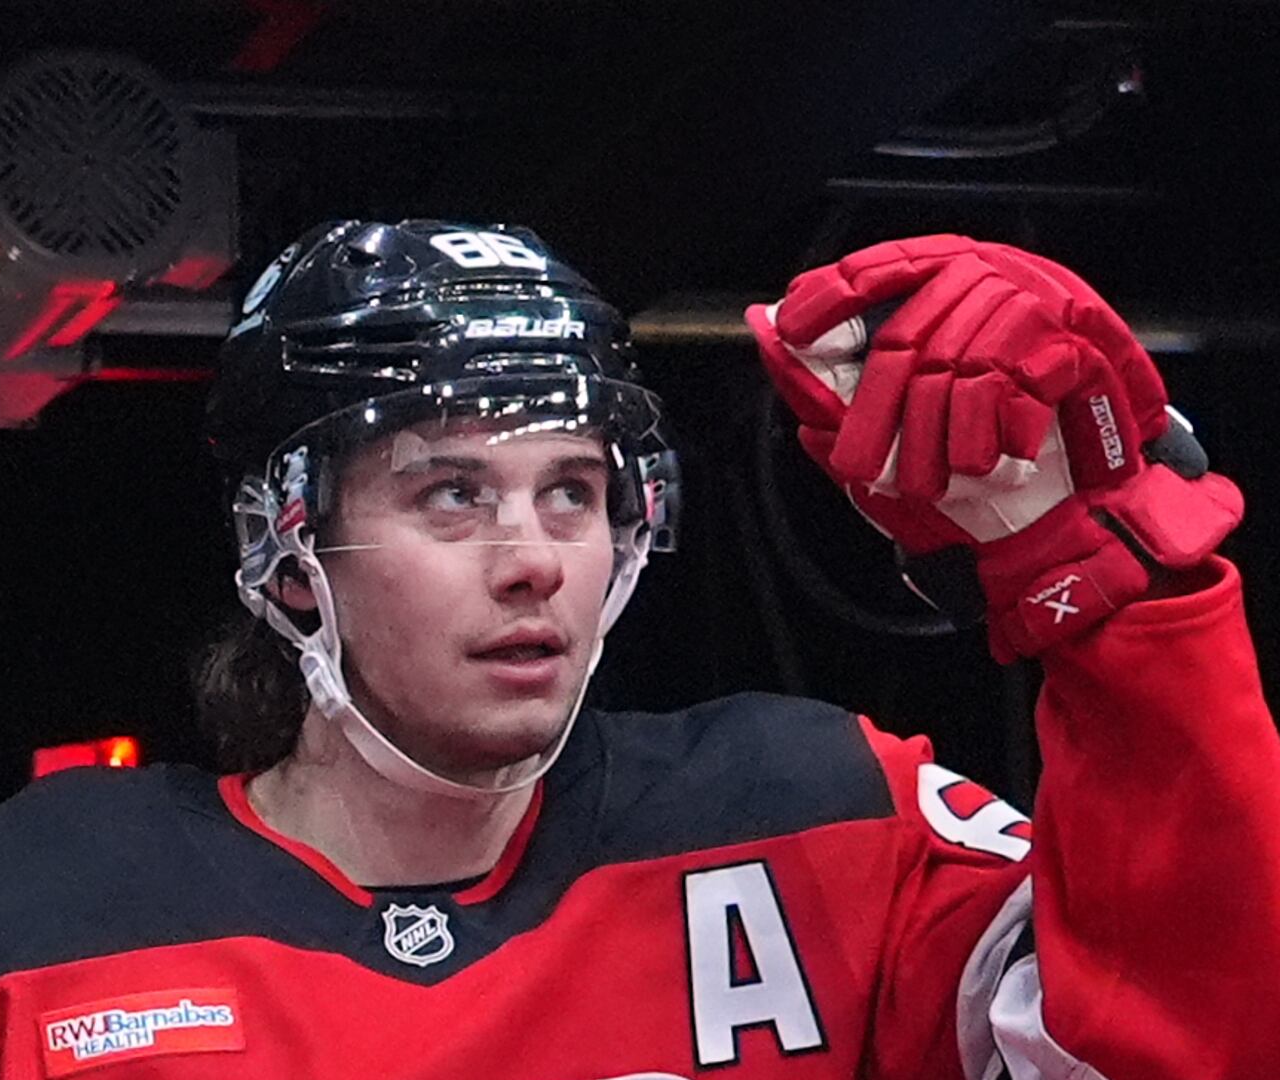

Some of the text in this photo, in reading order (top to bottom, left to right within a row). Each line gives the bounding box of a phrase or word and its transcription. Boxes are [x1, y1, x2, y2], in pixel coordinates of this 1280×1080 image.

[430, 231, 548, 270] 86
[401, 922, 438, 952] NHL
[682, 860, 828, 1068] A
[74, 1028, 153, 1058] HEALTH
